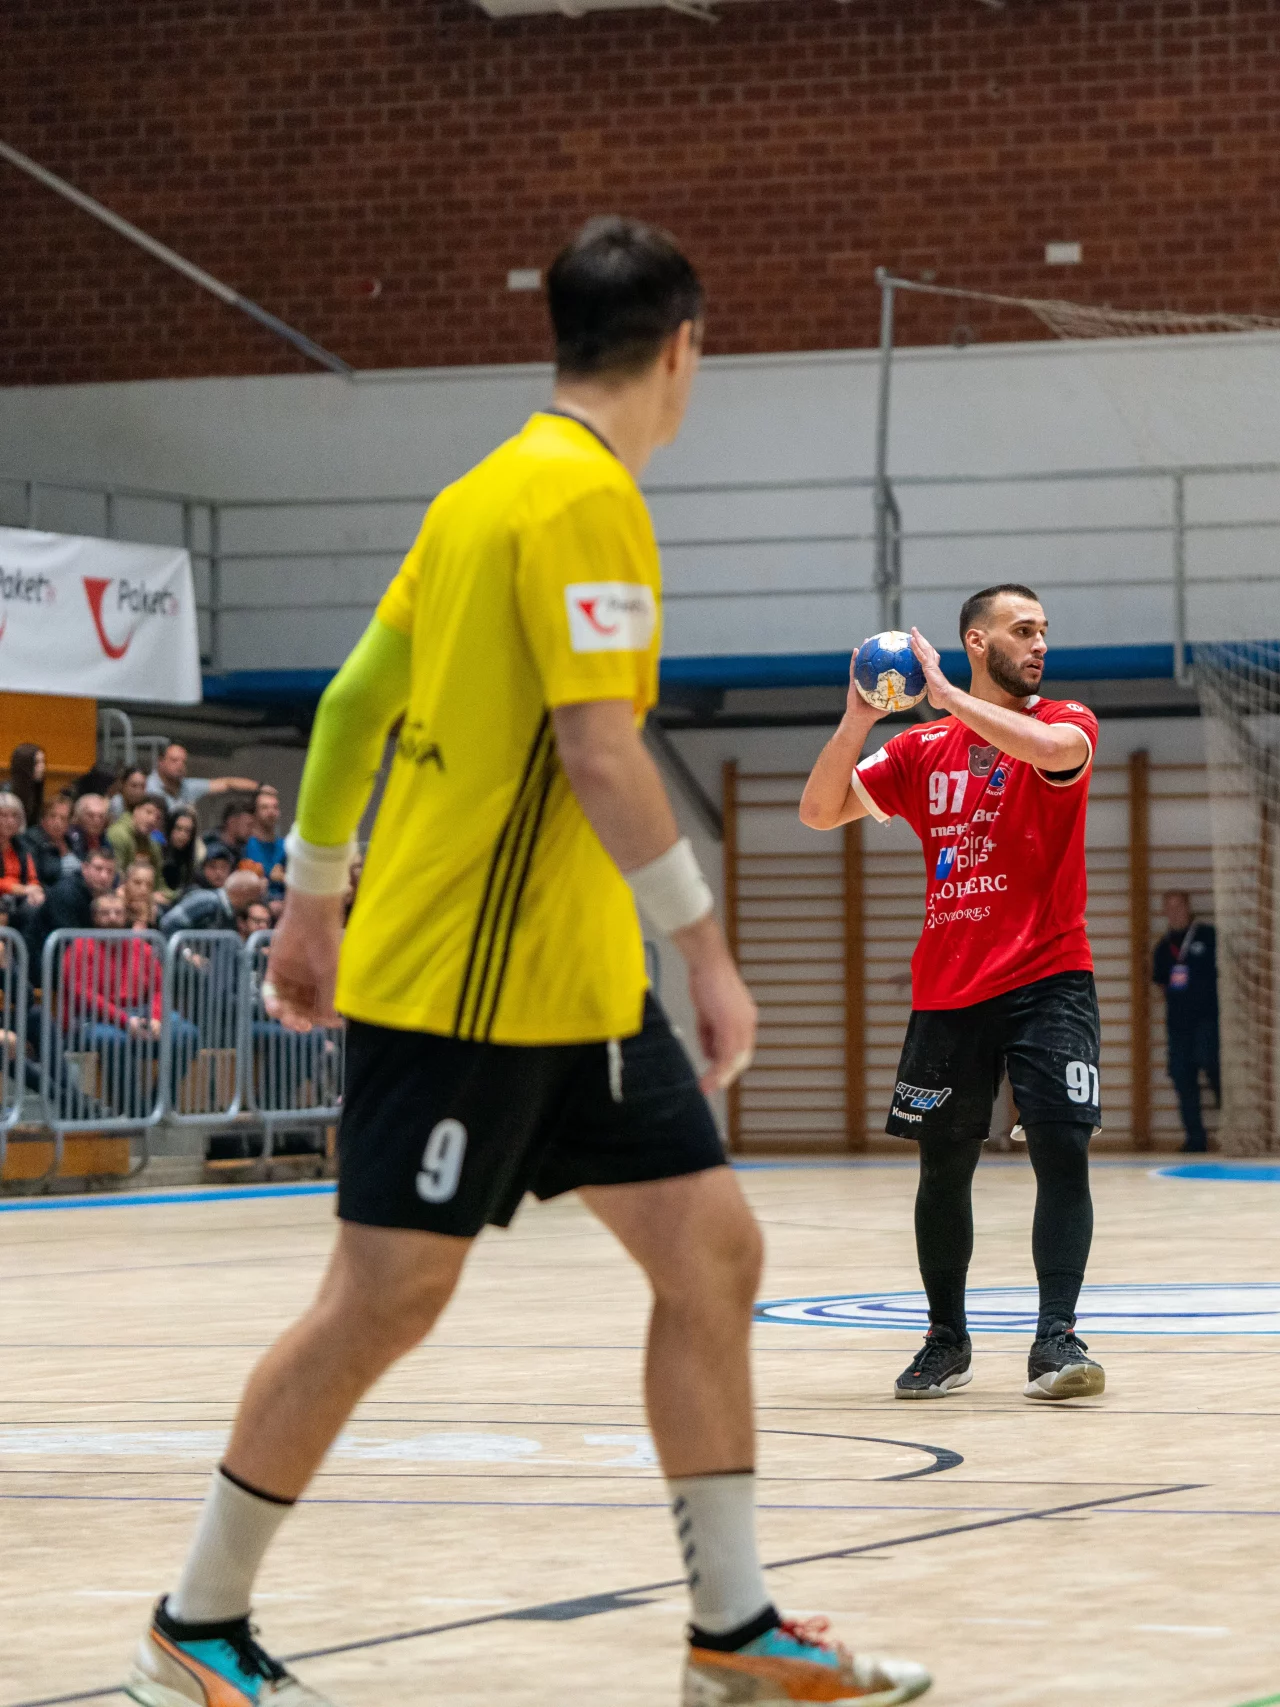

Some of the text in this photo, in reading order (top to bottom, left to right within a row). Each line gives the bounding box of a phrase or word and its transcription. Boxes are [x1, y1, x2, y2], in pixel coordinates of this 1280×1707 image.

[928, 770, 969, 815] 97
[892, 1106, 923, 1123] Kempa
[415, 1118, 468, 1204] 9
